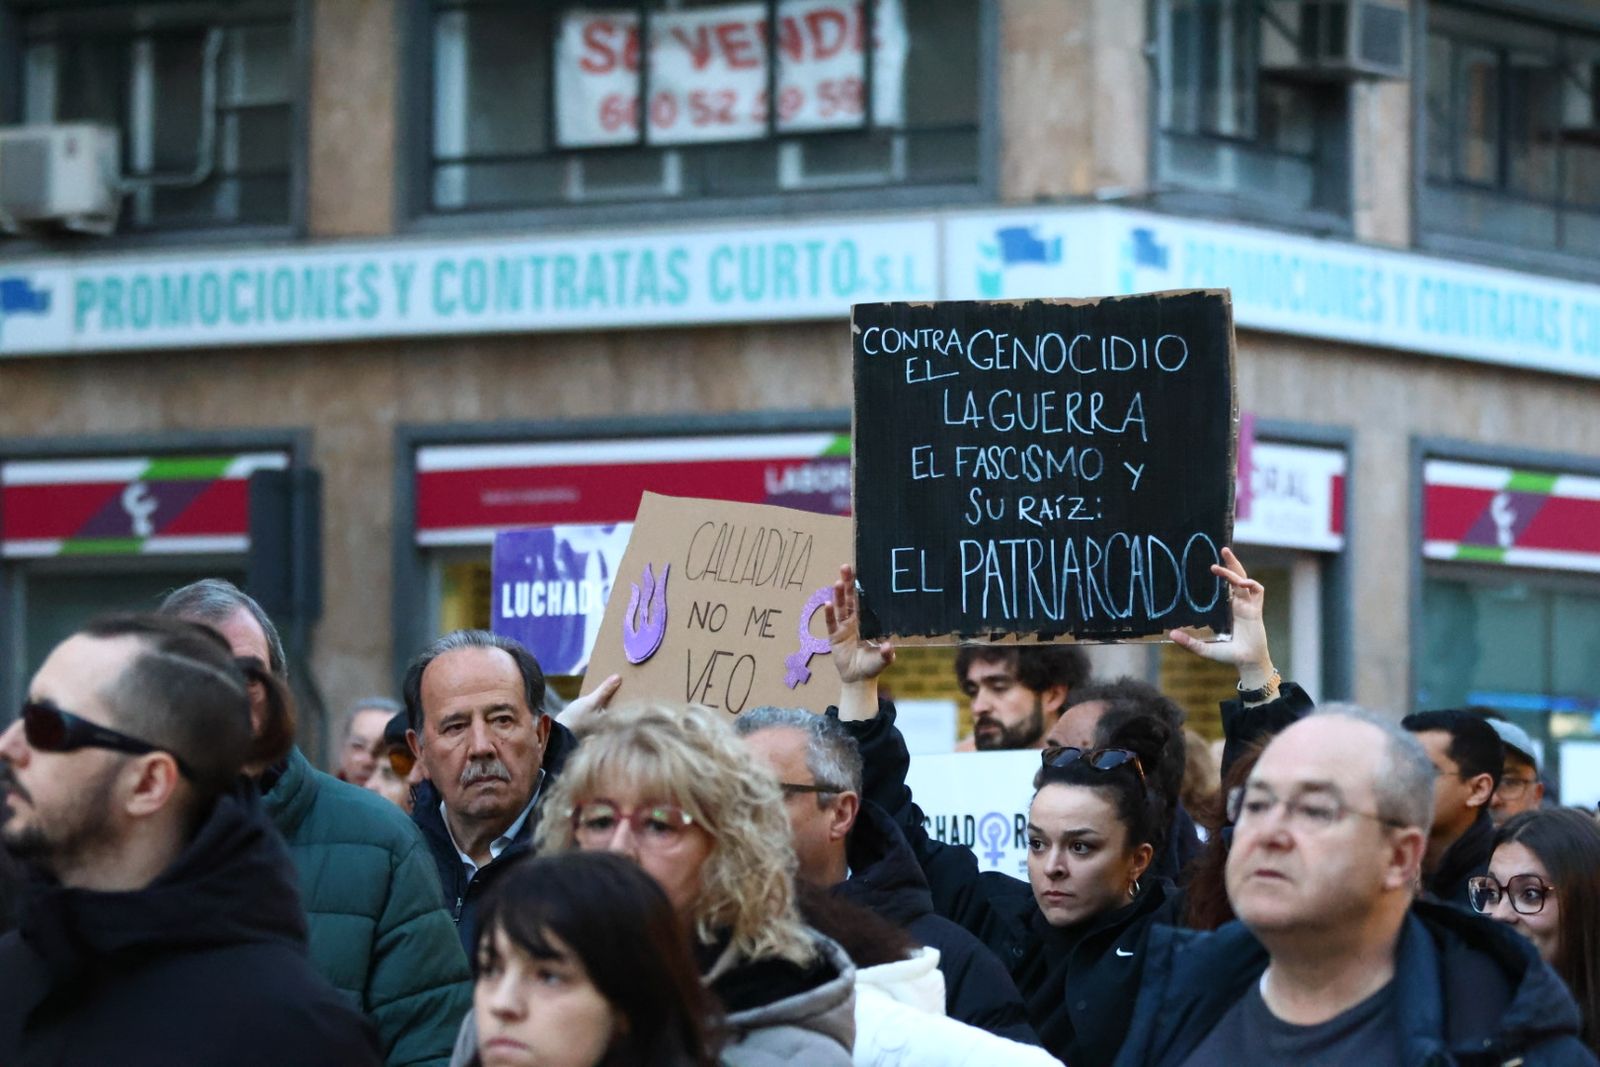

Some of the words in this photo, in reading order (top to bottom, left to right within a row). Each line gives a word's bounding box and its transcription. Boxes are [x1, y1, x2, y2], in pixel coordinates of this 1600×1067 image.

[74, 261, 381, 331] PROMOCIONES
[391, 260, 415, 318] Y
[432, 248, 690, 316] CONTRATAS
[862, 326, 964, 356] CONTRA
[967, 329, 1188, 374] GENOCIDIO
[905, 356, 960, 384] EL
[943, 389, 984, 428] LA
[988, 389, 1148, 443] GUERRA
[911, 445, 945, 480] EL
[955, 444, 1104, 482] FASCISMO
[965, 486, 1006, 526] SU
[685, 520, 813, 592] CALLADITA
[891, 546, 944, 594] EL
[959, 532, 1221, 622] PATRIARCADO
[686, 600, 728, 633] NO
[743, 605, 783, 639] ME
[686, 647, 756, 715] VEO
